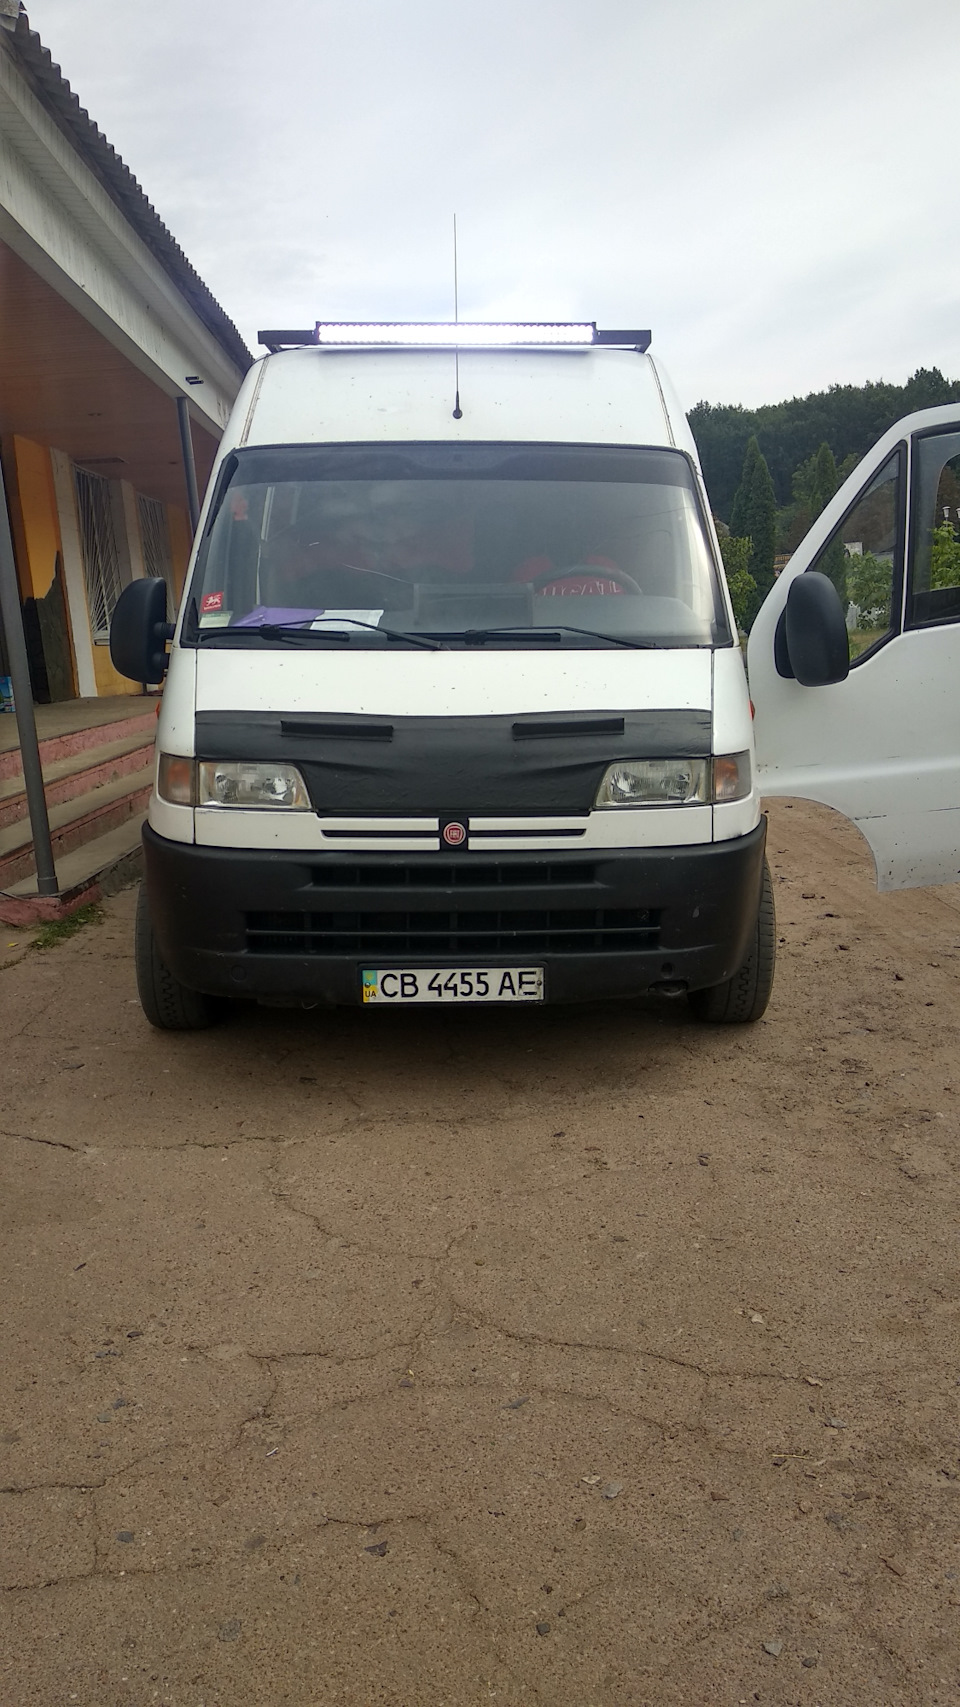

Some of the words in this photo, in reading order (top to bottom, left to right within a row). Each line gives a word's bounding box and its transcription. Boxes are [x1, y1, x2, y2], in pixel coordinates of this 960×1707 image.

[380, 973, 419, 998] CB
[427, 972, 489, 997] 4455
[498, 971, 537, 996] AE
[365, 990, 377, 998] UA
